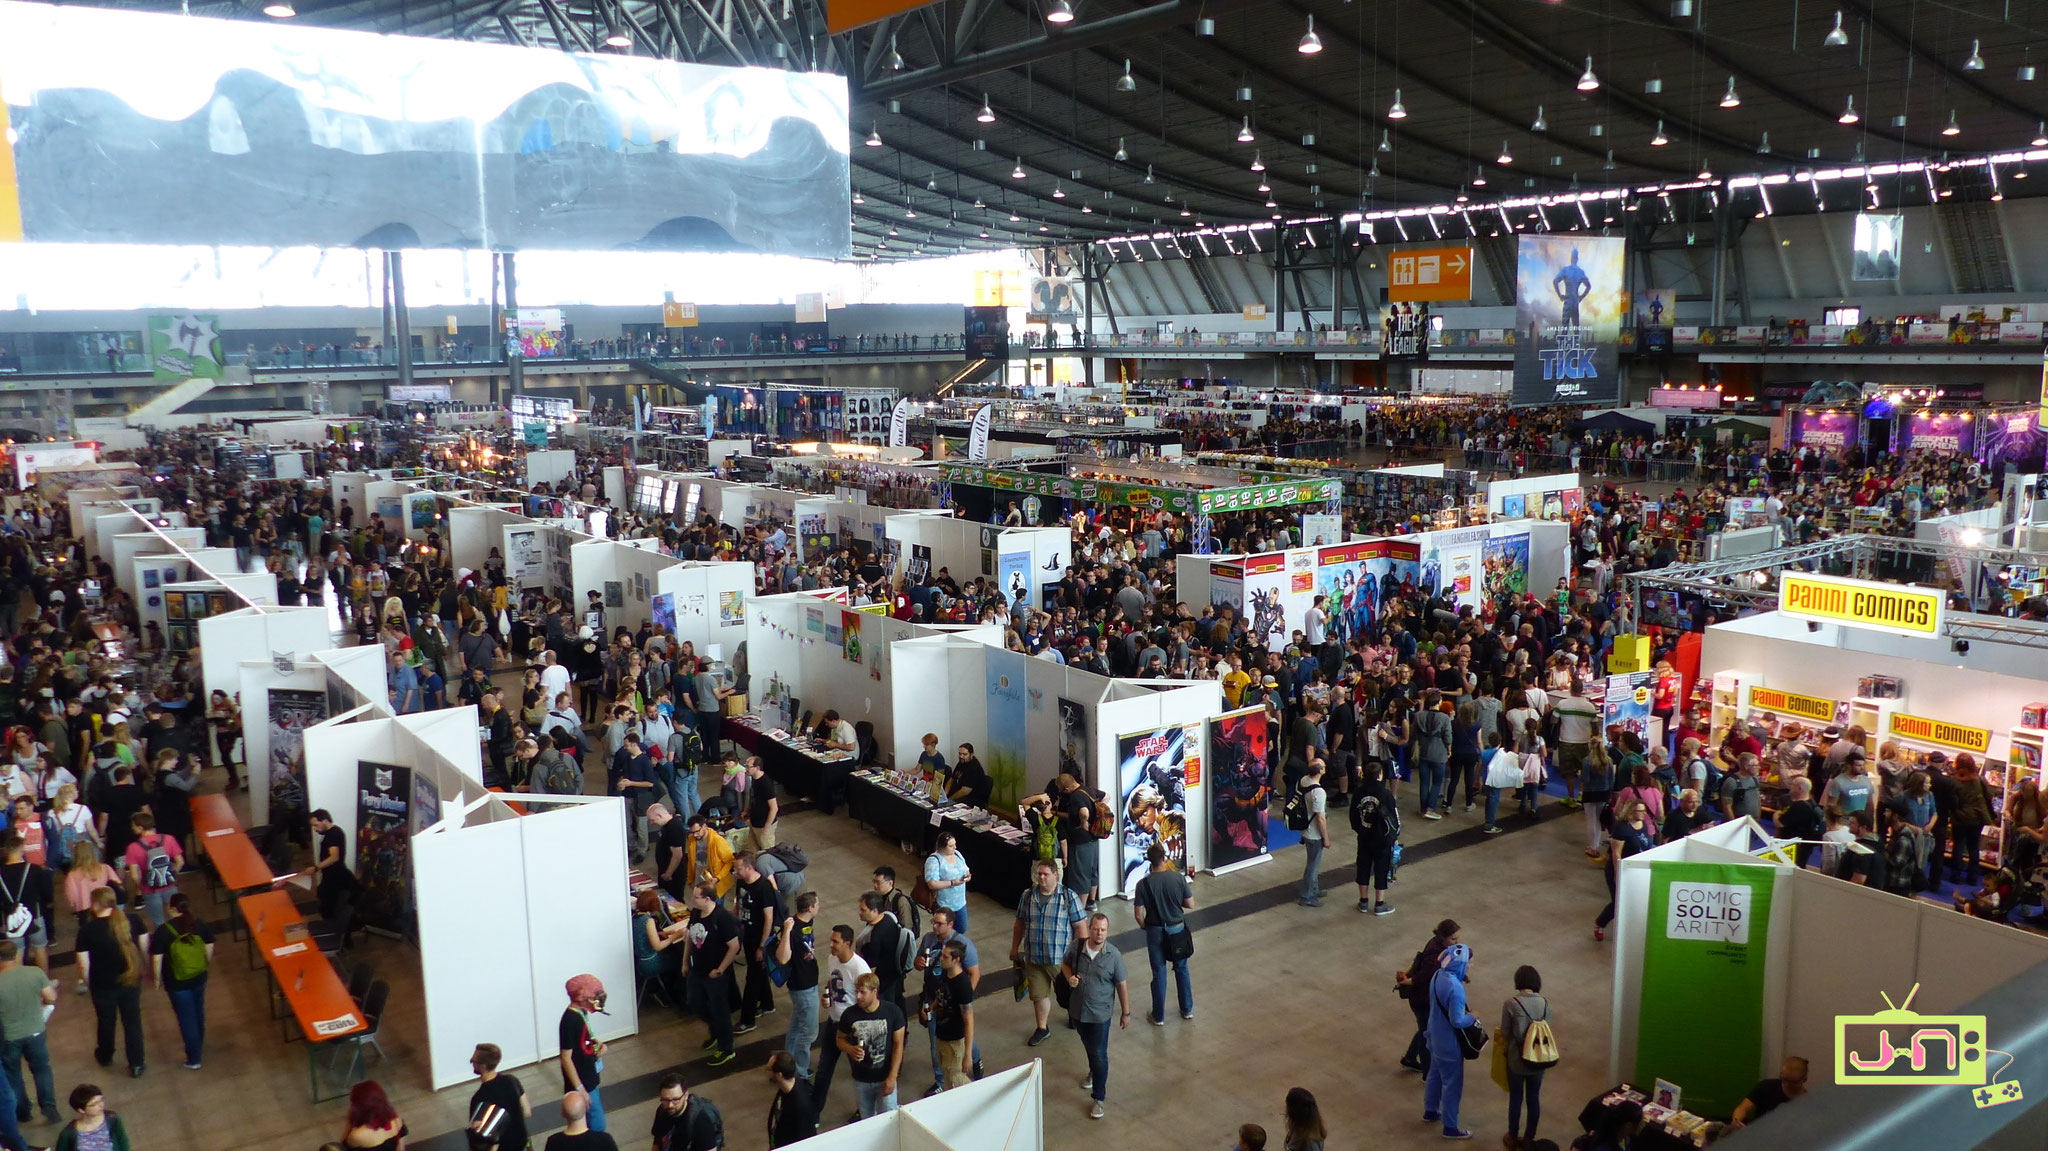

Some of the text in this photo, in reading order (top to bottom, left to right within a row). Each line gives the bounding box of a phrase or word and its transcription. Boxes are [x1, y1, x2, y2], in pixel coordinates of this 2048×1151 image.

[1397, 314, 1412, 331] THE
[1389, 336, 1419, 355] LEAGUE
[1556, 334, 1581, 350] THE
[1539, 348, 1598, 380] TICK
[1136, 736, 1168, 749] STAR
[1136, 744, 1168, 758] WARS
[1676, 888, 1742, 906] COMIC
[1675, 904, 1742, 921] SOLID
[1674, 919, 1741, 936] ARITY
